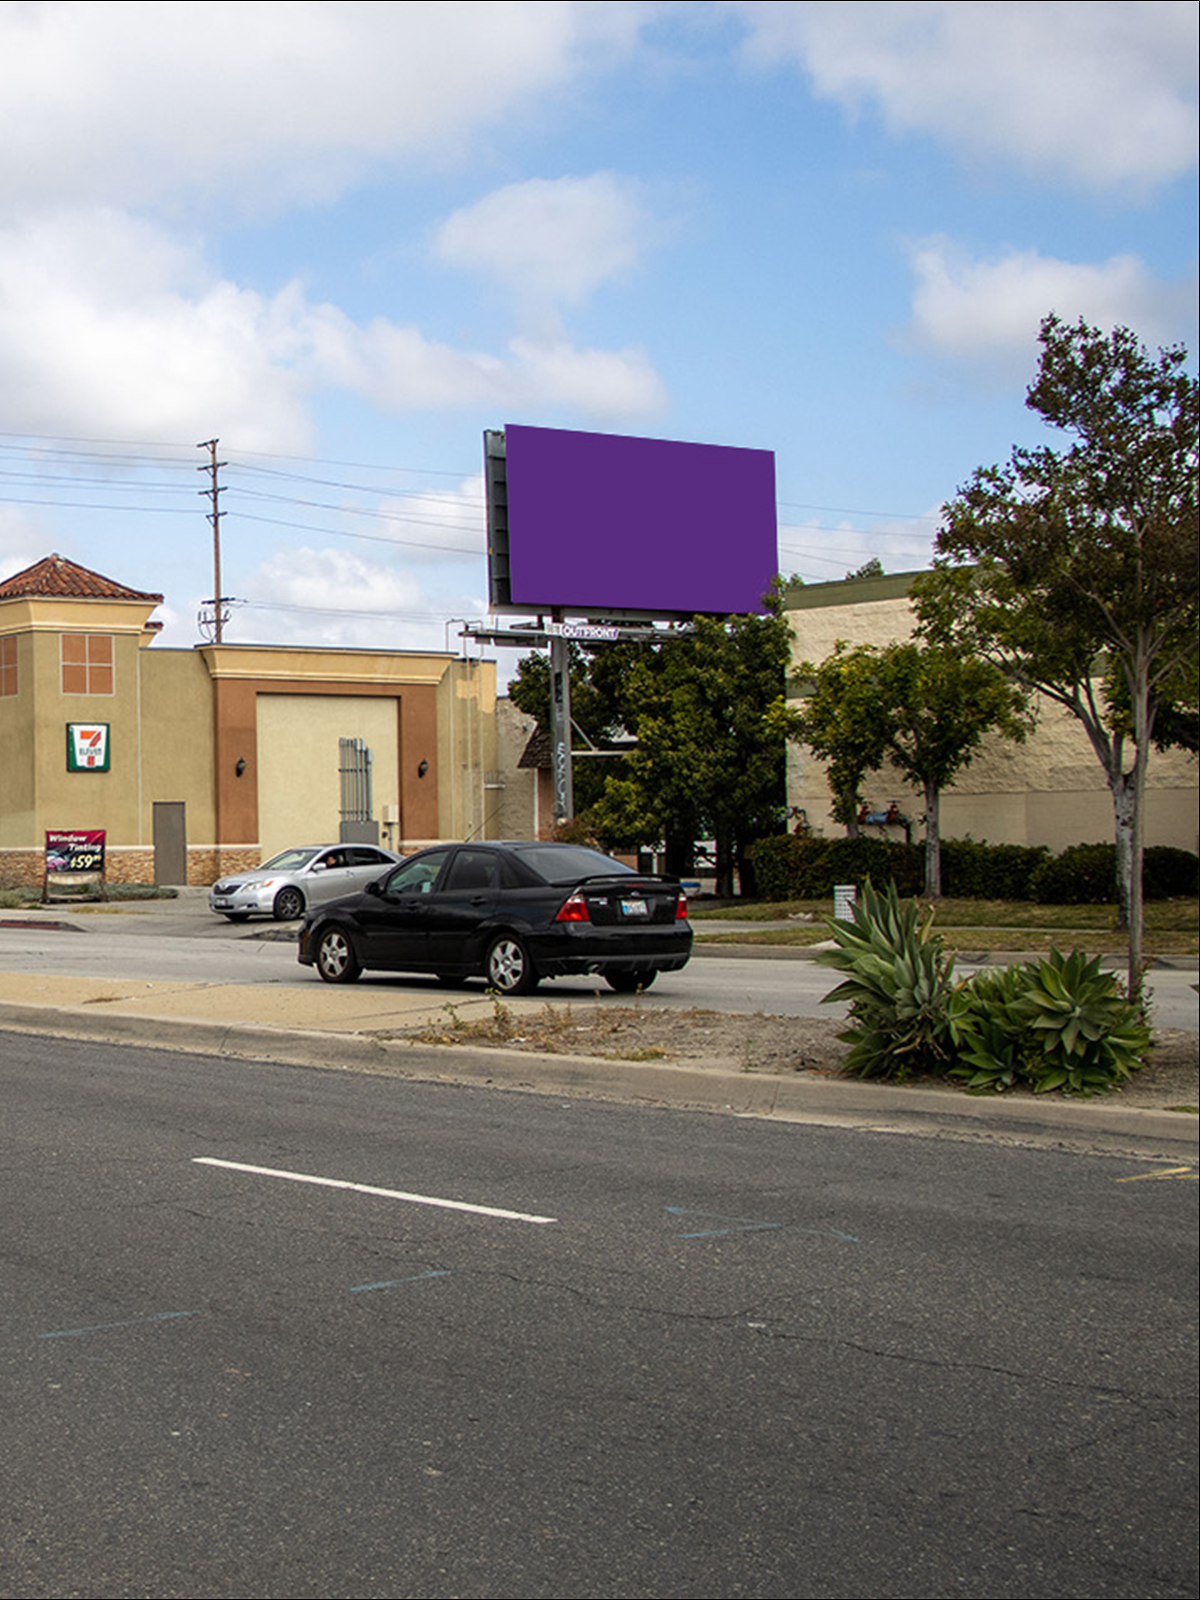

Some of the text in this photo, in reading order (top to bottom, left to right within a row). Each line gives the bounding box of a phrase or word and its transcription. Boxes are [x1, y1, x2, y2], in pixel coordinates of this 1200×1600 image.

[563, 625, 618, 640] OUTFRONT
[49, 834, 88, 842] Window
[69, 843, 102, 853] Tinting
